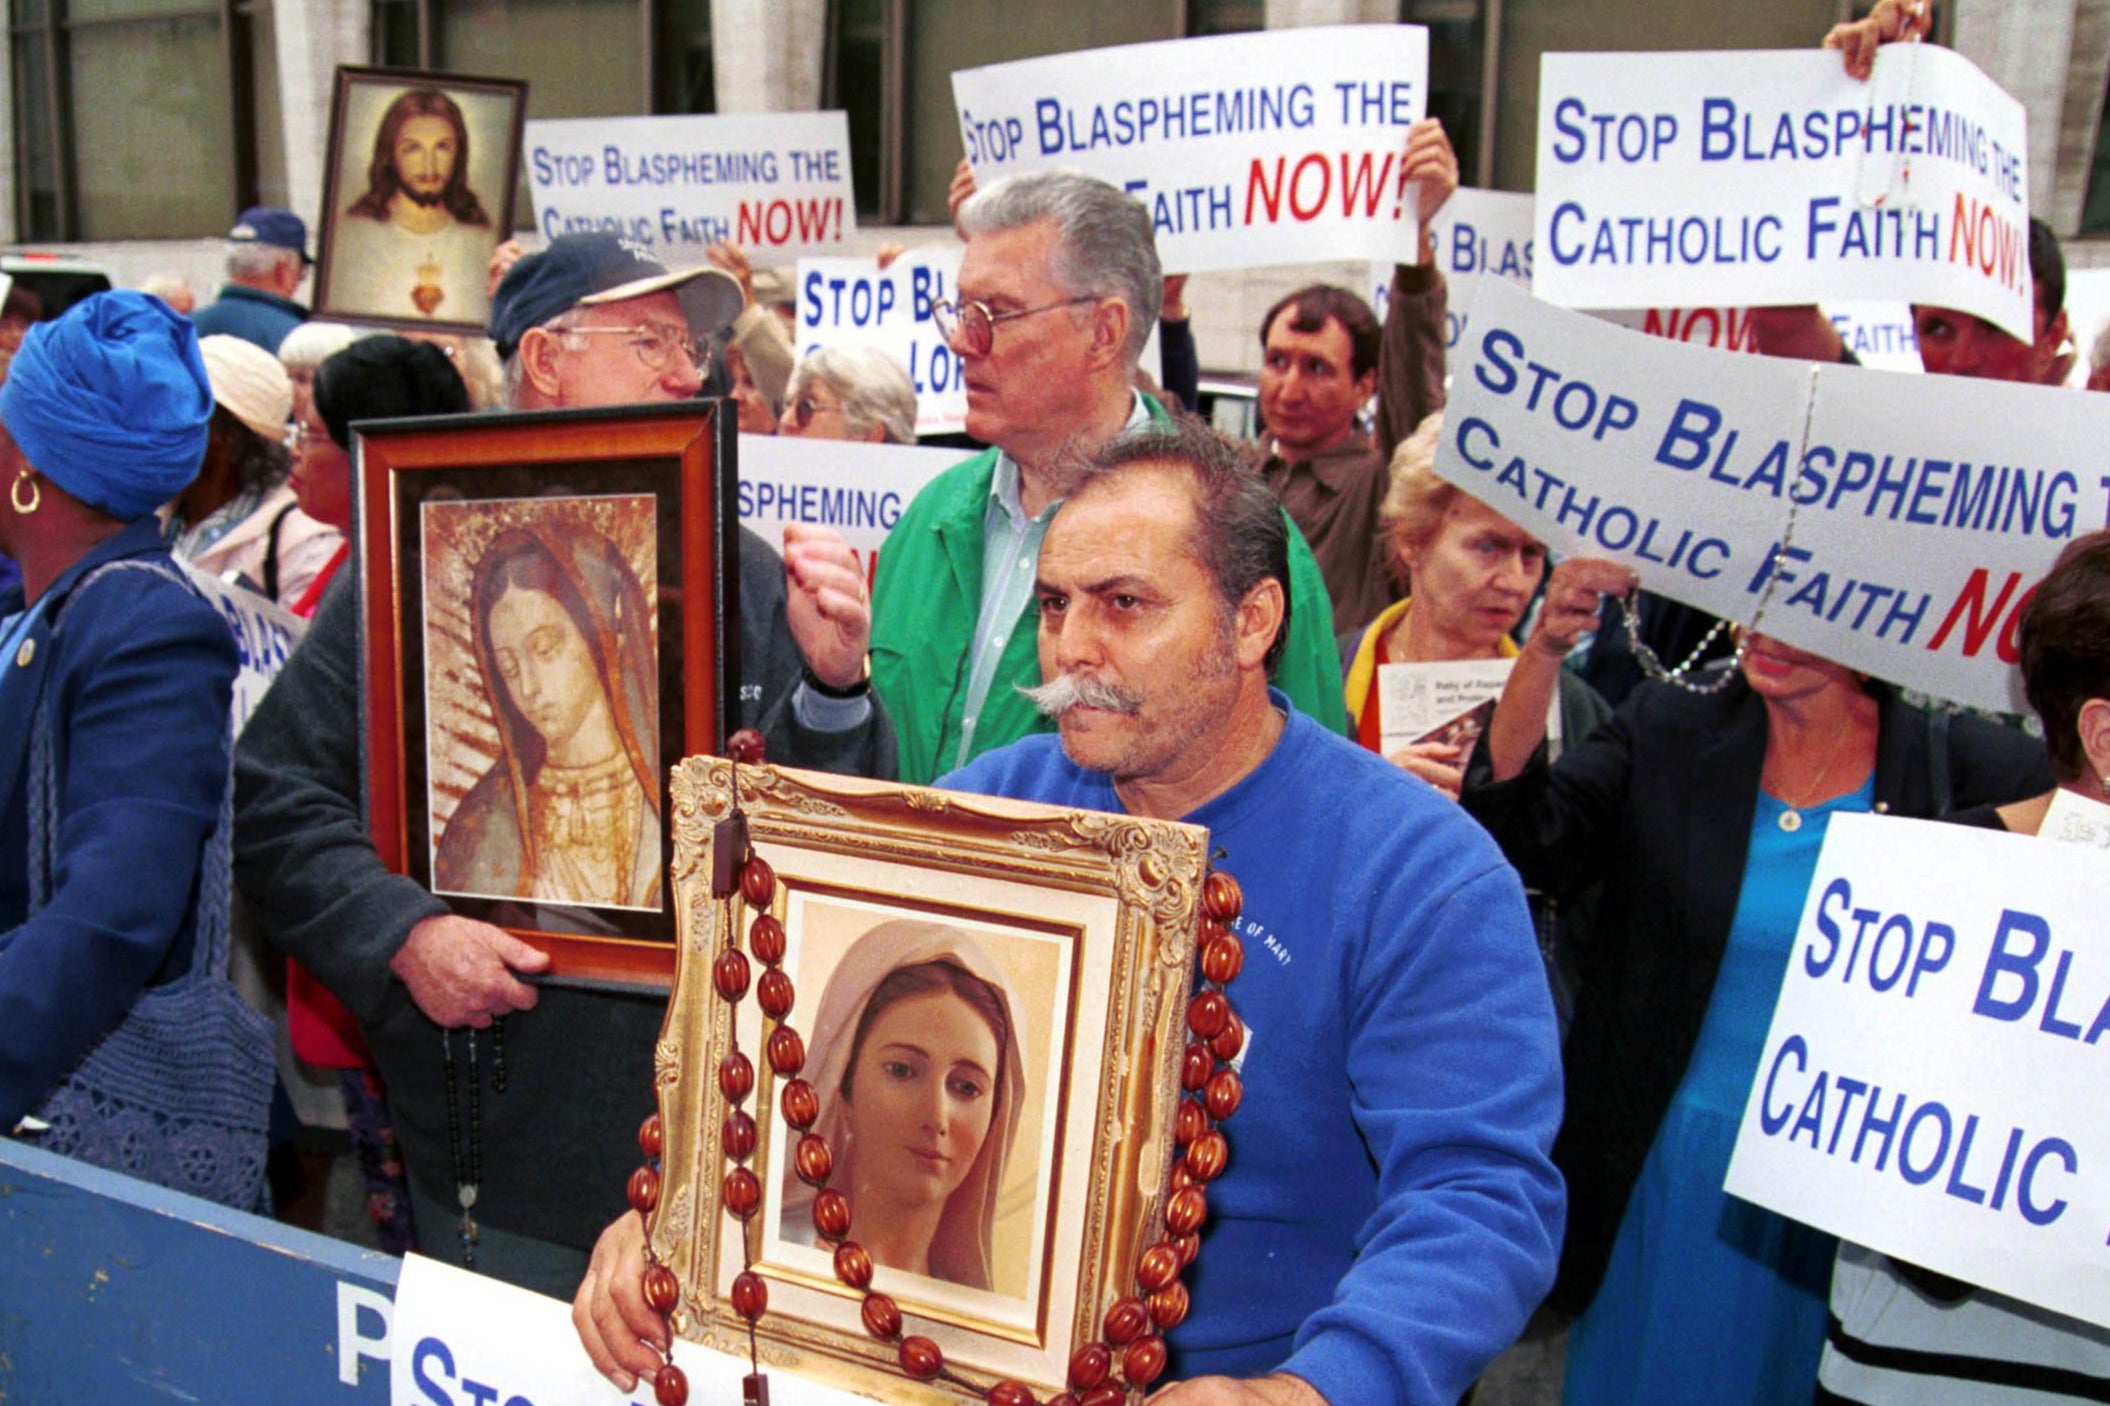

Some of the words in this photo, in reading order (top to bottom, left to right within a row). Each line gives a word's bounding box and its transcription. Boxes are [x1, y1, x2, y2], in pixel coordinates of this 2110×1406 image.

[532, 146, 594, 185] STOP
[603, 145, 779, 185] BLASPHEMING
[788, 149, 841, 182] THE
[963, 109, 1023, 165] STOP
[1035, 82, 1315, 156] BLASPHEMING
[1335, 80, 1412, 126] THE
[1552, 97, 1677, 164] STOP
[1700, 97, 1988, 175] BLASPHEMING
[1992, 139, 2021, 204] THE
[659, 207, 730, 244] FAITH
[737, 197, 844, 246] NOW!
[1549, 202, 1784, 267] CATHOLIC
[1806, 196, 1939, 261] FAITH
[1948, 191, 2024, 297] NOW!
[804, 271, 896, 327] STOP
[1474, 328, 1639, 441] STOP
[1654, 397, 2079, 539] BLASPHEMING
[1456, 416, 1732, 580] CATHOLIC
[1746, 541, 1933, 646] FAITH
[1246, 922, 1264, 937] OF
[1263, 934, 1292, 966] MARY
[1804, 877, 1956, 998] STOP
[1759, 1034, 2078, 1226] CATHOLIC
